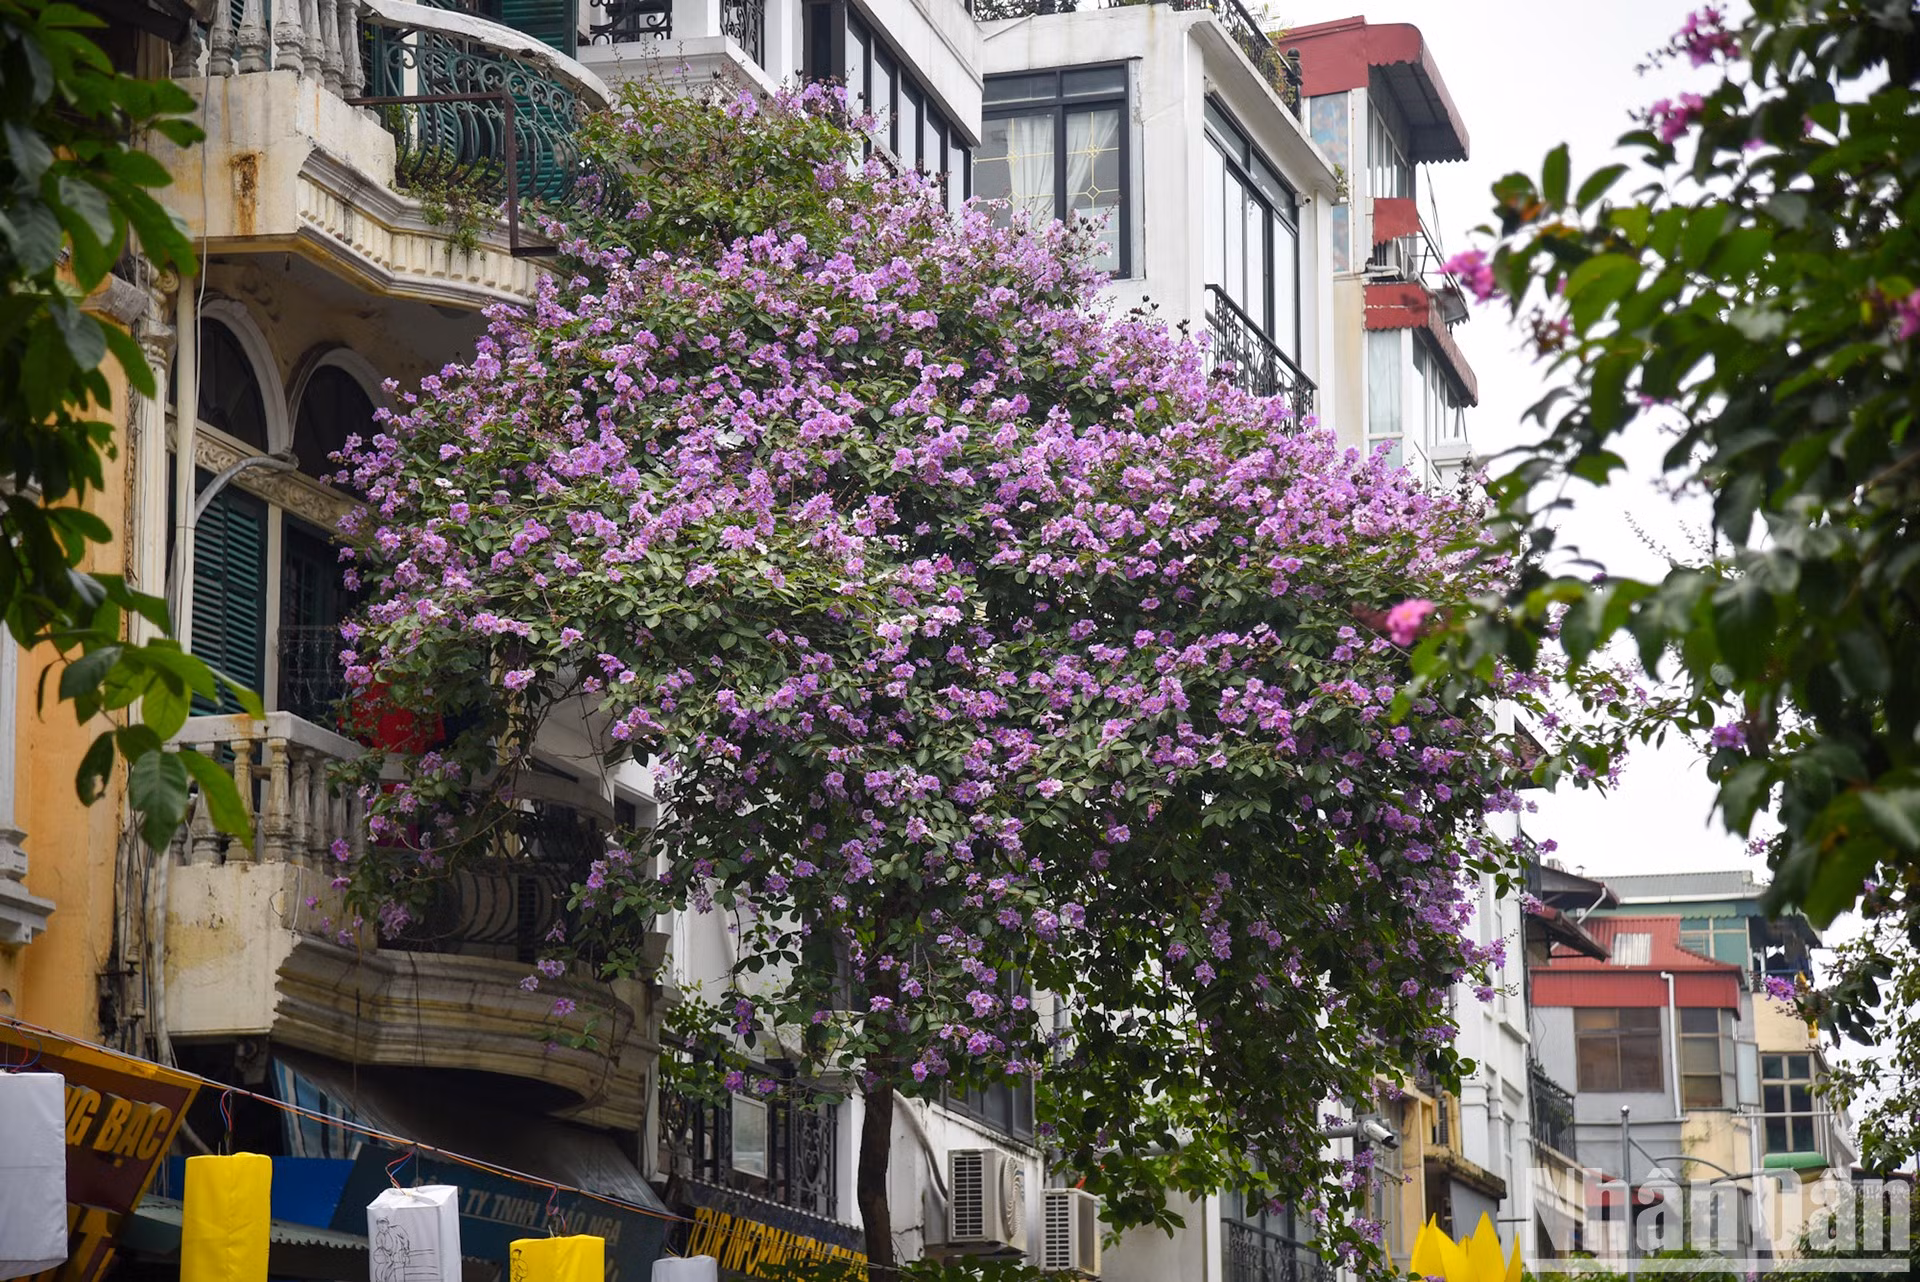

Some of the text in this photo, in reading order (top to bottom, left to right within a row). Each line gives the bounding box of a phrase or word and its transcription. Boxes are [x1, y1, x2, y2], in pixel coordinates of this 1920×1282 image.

[92, 1093, 172, 1168] BẠC
[463, 1188, 492, 1215] TY
[490, 1192, 541, 1226] TNHH
[687, 1206, 732, 1264] TOUR
